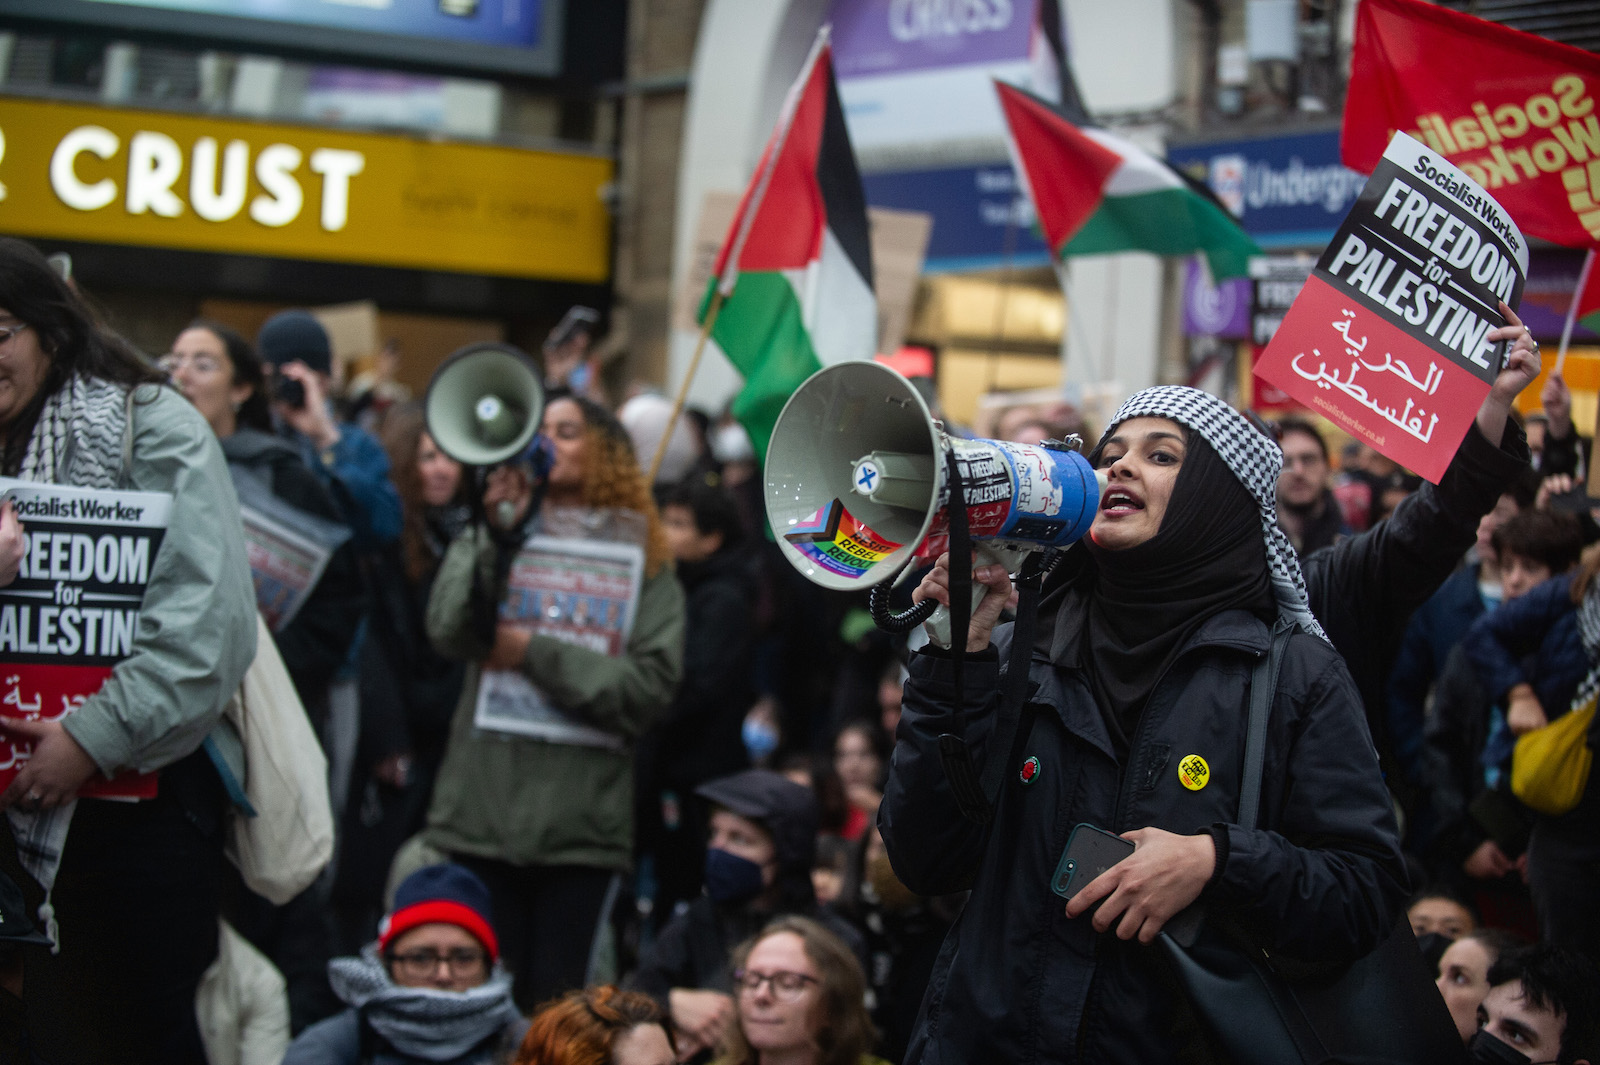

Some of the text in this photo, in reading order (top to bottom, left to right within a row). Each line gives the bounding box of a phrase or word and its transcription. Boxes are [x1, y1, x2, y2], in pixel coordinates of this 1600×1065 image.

[50, 125, 366, 232] CRUST
[1373, 177, 1517, 304] FREEDOM
[1422, 255, 1452, 285] for
[1328, 233, 1502, 370] PALESTINE
[1331, 308, 1444, 396] الحرية
[1290, 348, 1440, 444] لفلسطين
[1313, 396, 1387, 447] socialistworker.co.uk
[19, 531, 150, 585] REEDOM
[826, 546, 875, 569] REVOLT
[838, 538, 878, 560] REBEL
[851, 530, 892, 554] RESIST
[55, 581, 83, 606] for
[0, 604, 141, 656] ALESTIN
